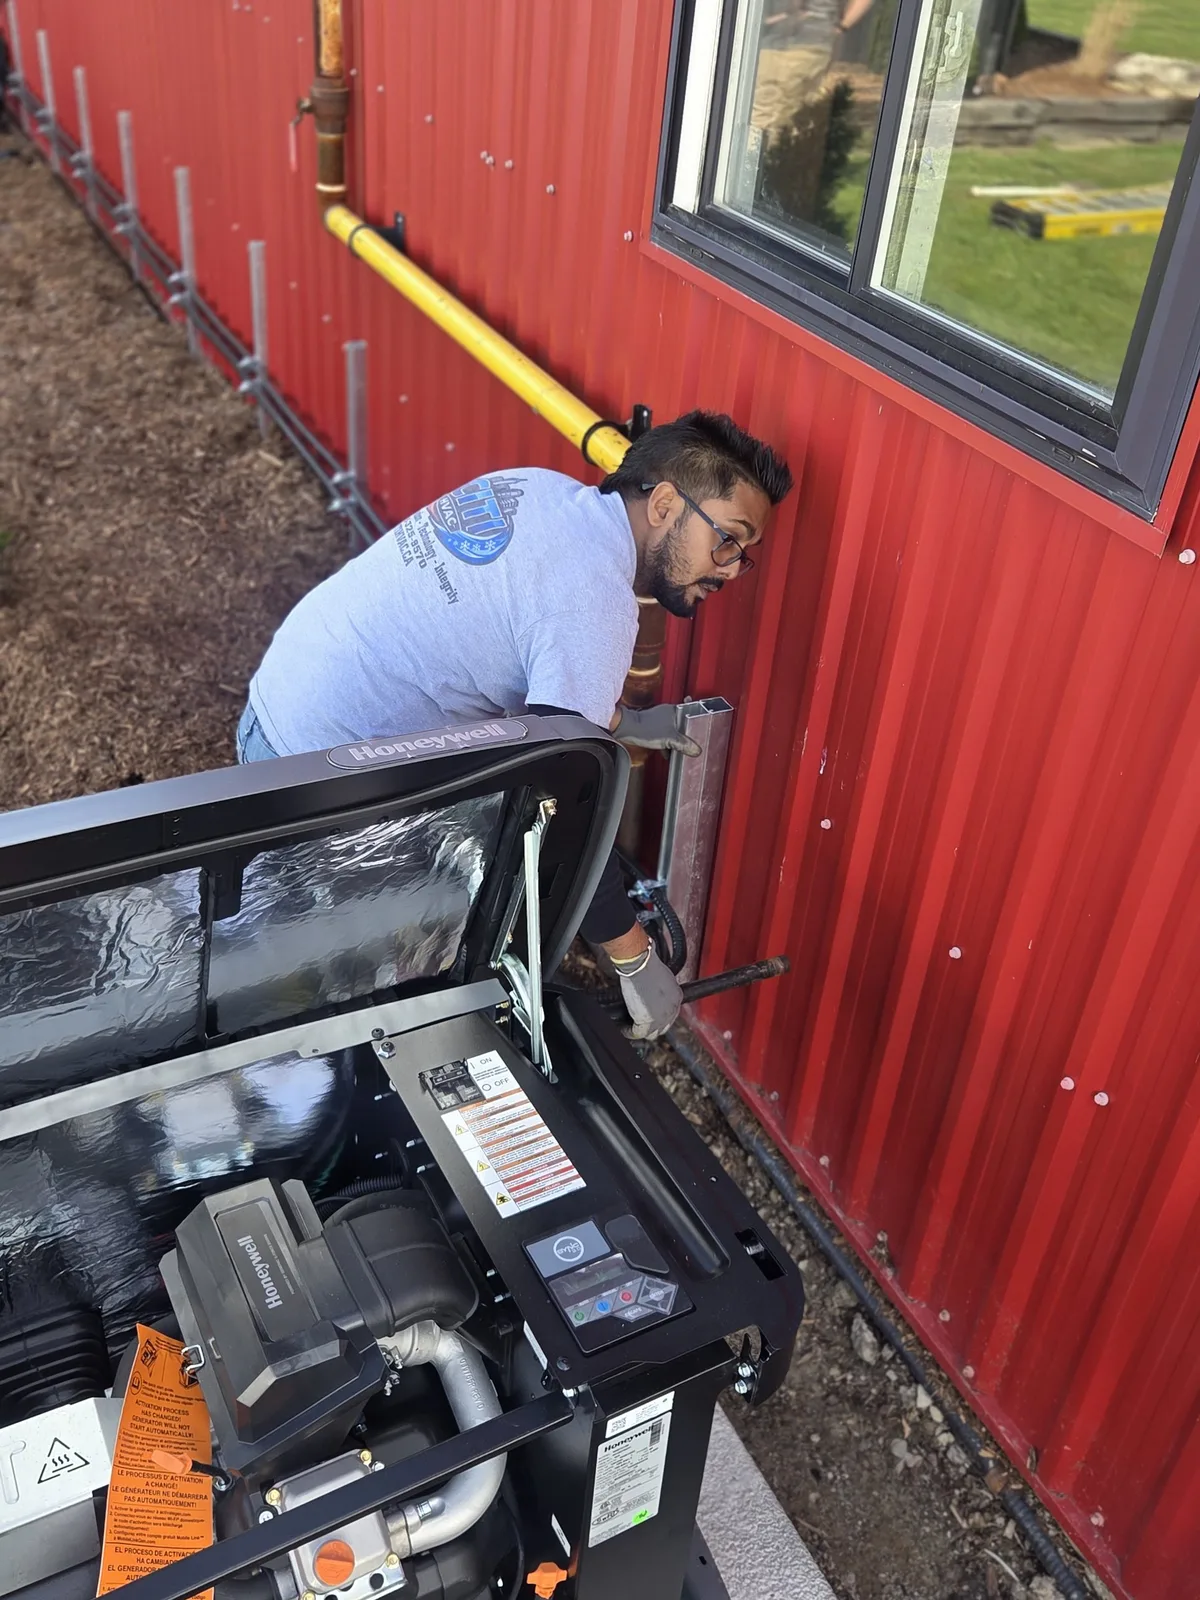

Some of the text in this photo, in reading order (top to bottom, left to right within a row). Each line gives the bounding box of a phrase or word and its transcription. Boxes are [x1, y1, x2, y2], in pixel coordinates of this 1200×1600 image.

[440, 496, 458, 531] HVAC
[417, 522, 436, 562] Technology
[434, 562, 459, 605] Integrity
[348, 724, 508, 761] Honeywell
[494, 1078, 510, 1086] OFF
[237, 1235, 283, 1309] Honeywell
[136, 1399, 189, 1416] ACTIVATION PROCESS
[132, 1415, 163, 1427] GENERATOR
[152, 1412, 181, 1422] CHANGED!
[130, 1423, 194, 1438] START AUTOMATICALLY!
[126, 1471, 162, 1480] PROCESSUS
[170, 1476, 203, 1484] ACTIVATION
[151, 1481, 178, 1489] CHANGÉ!
[121, 1486, 160, 1496] GÉNÉRATEUR
[172, 1491, 208, 1500] DÉMARRERA
[137, 1497, 197, 1508] AUTOMATIQUEMENT!
[125, 1548, 153, 1556] PROCESO
